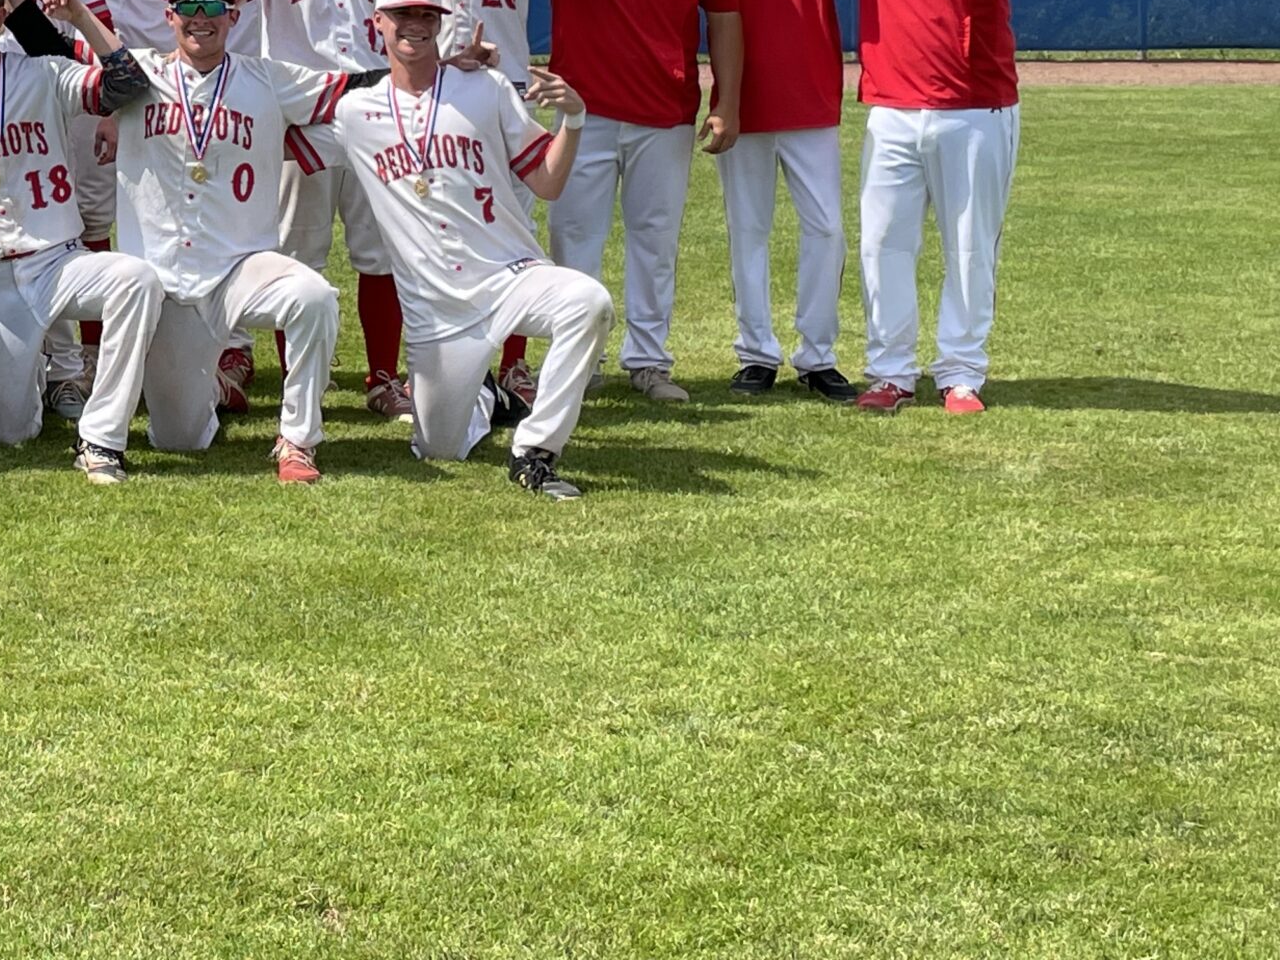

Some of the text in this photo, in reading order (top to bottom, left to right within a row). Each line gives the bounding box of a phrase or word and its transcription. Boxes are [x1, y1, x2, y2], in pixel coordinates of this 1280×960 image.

[145, 103, 182, 139] RED
[231, 162, 255, 203] 0
[374, 142, 412, 186] RED
[24, 164, 72, 210] 18
[474, 186, 495, 224] 7
